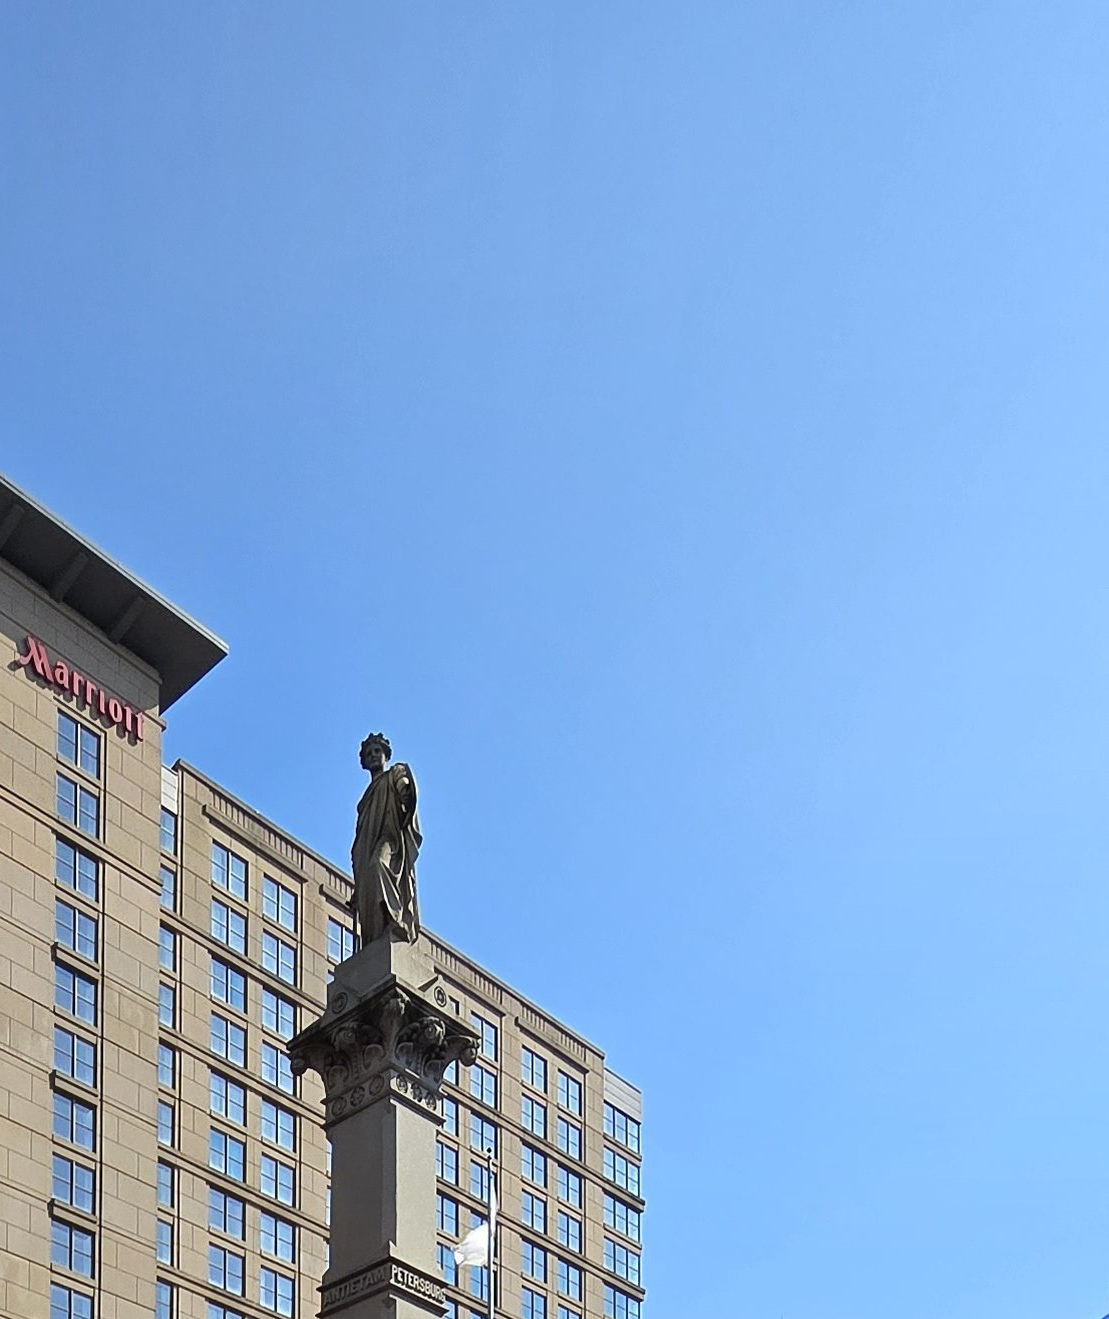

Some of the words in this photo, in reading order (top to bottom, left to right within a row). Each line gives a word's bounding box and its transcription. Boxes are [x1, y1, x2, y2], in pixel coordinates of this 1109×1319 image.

[19, 635, 145, 742] Marriott
[324, 1268, 385, 1304] ANTIETAM
[392, 1264, 446, 1301] PETERSBURG
